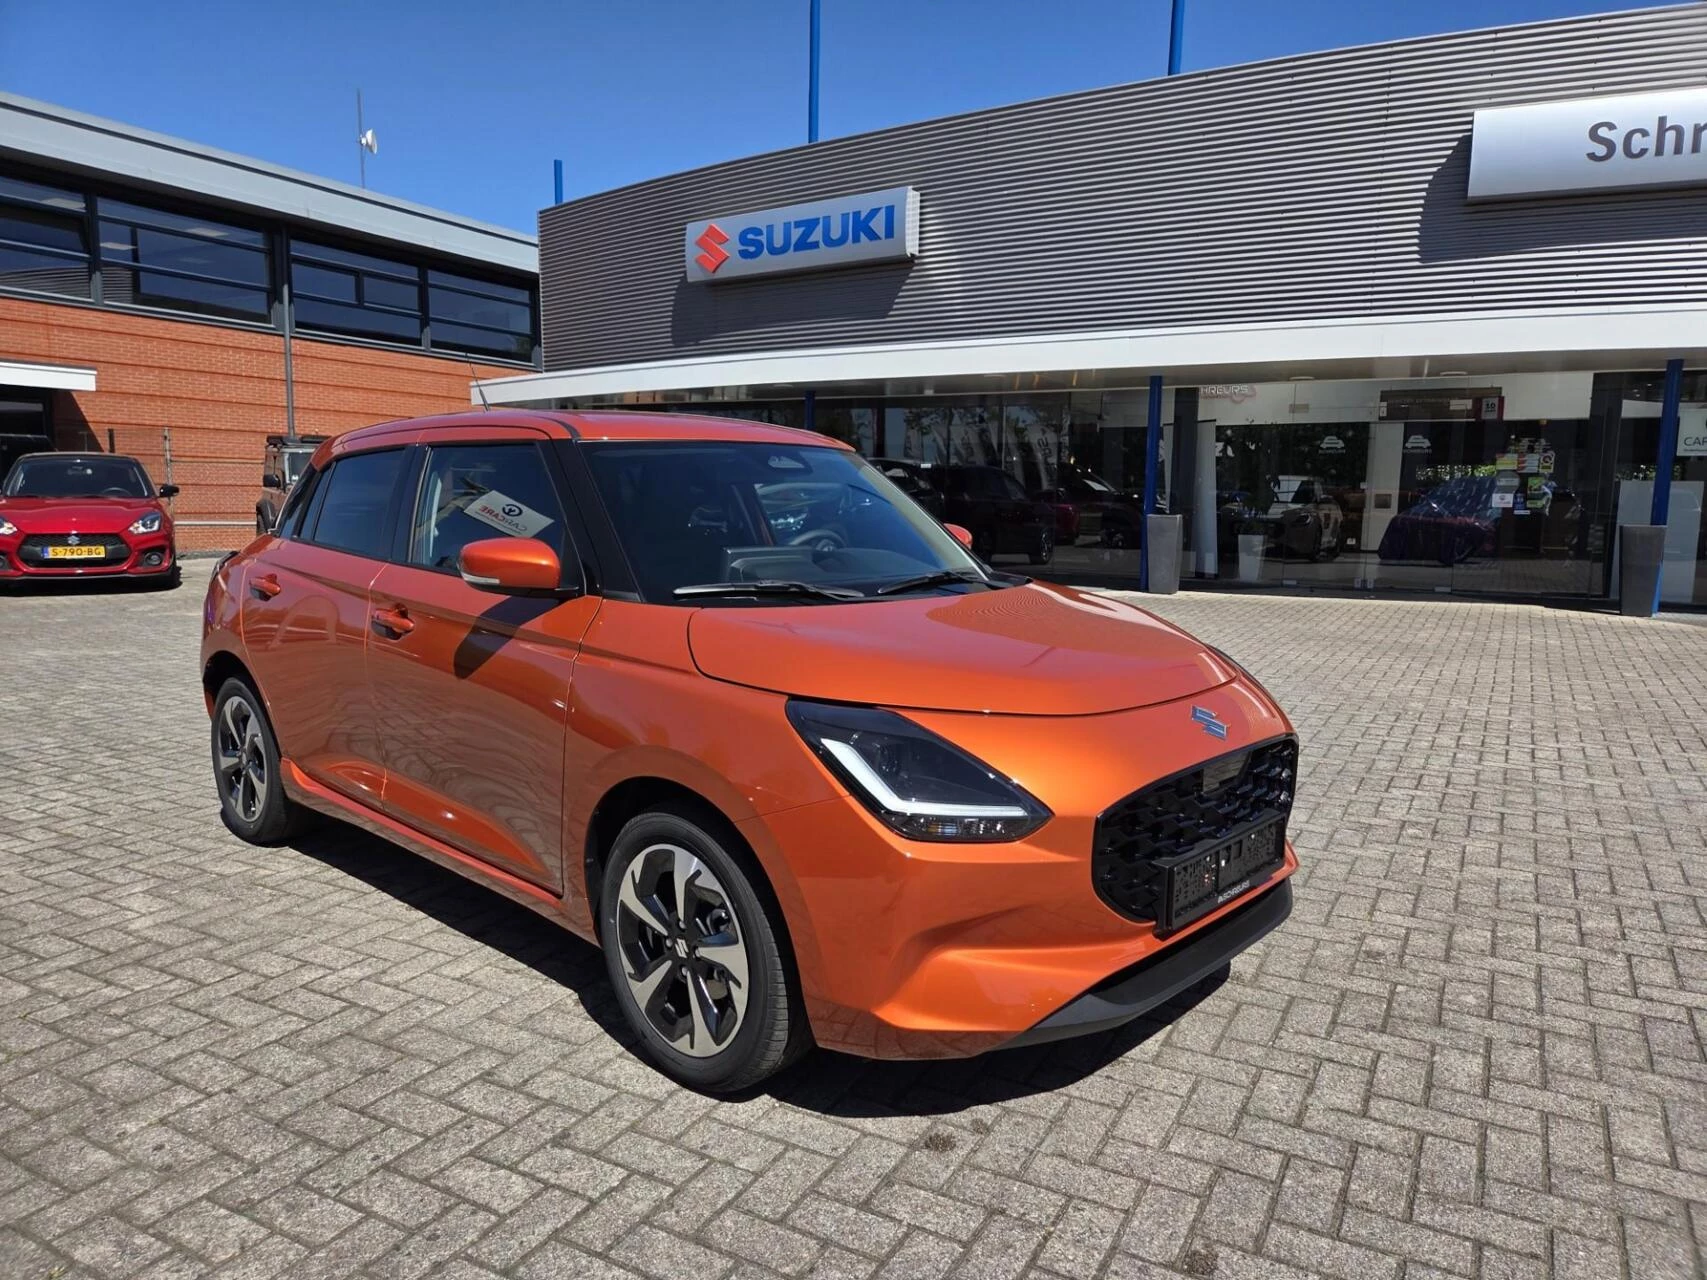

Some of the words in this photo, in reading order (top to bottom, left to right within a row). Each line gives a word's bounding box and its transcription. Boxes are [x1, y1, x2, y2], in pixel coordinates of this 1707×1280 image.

[1586, 115, 1707, 162] Schr
[738, 205, 896, 260] SUZUKI
[51, 548, 102, 557] S-790-BG
